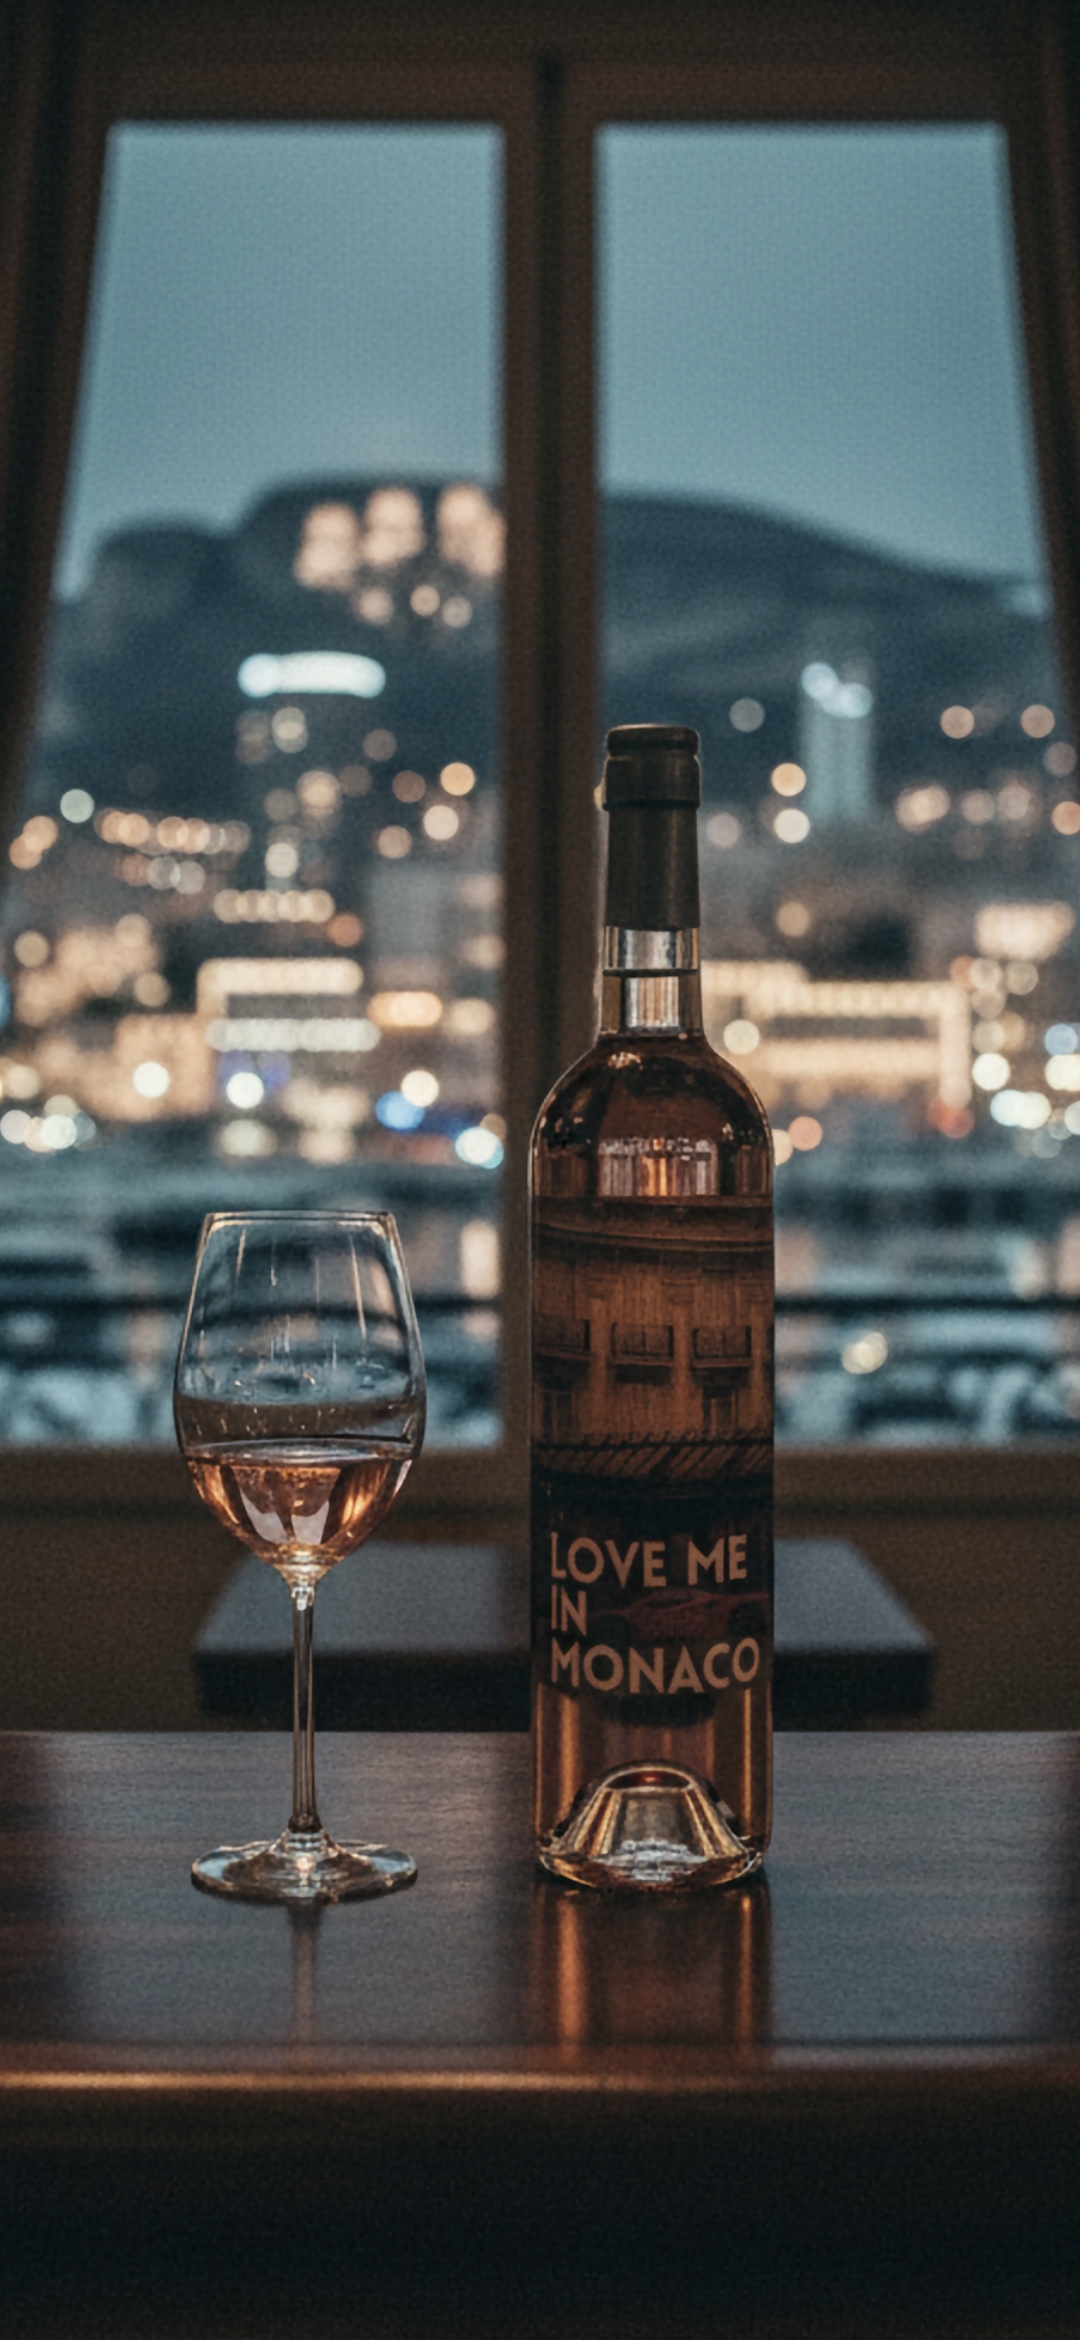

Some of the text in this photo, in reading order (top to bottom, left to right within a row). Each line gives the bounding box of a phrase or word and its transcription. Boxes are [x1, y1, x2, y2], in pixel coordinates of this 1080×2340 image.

[551, 1531, 748, 1588] LOVE ME
[551, 1584, 587, 1636] IN
[551, 1637, 760, 1694] MONACO
